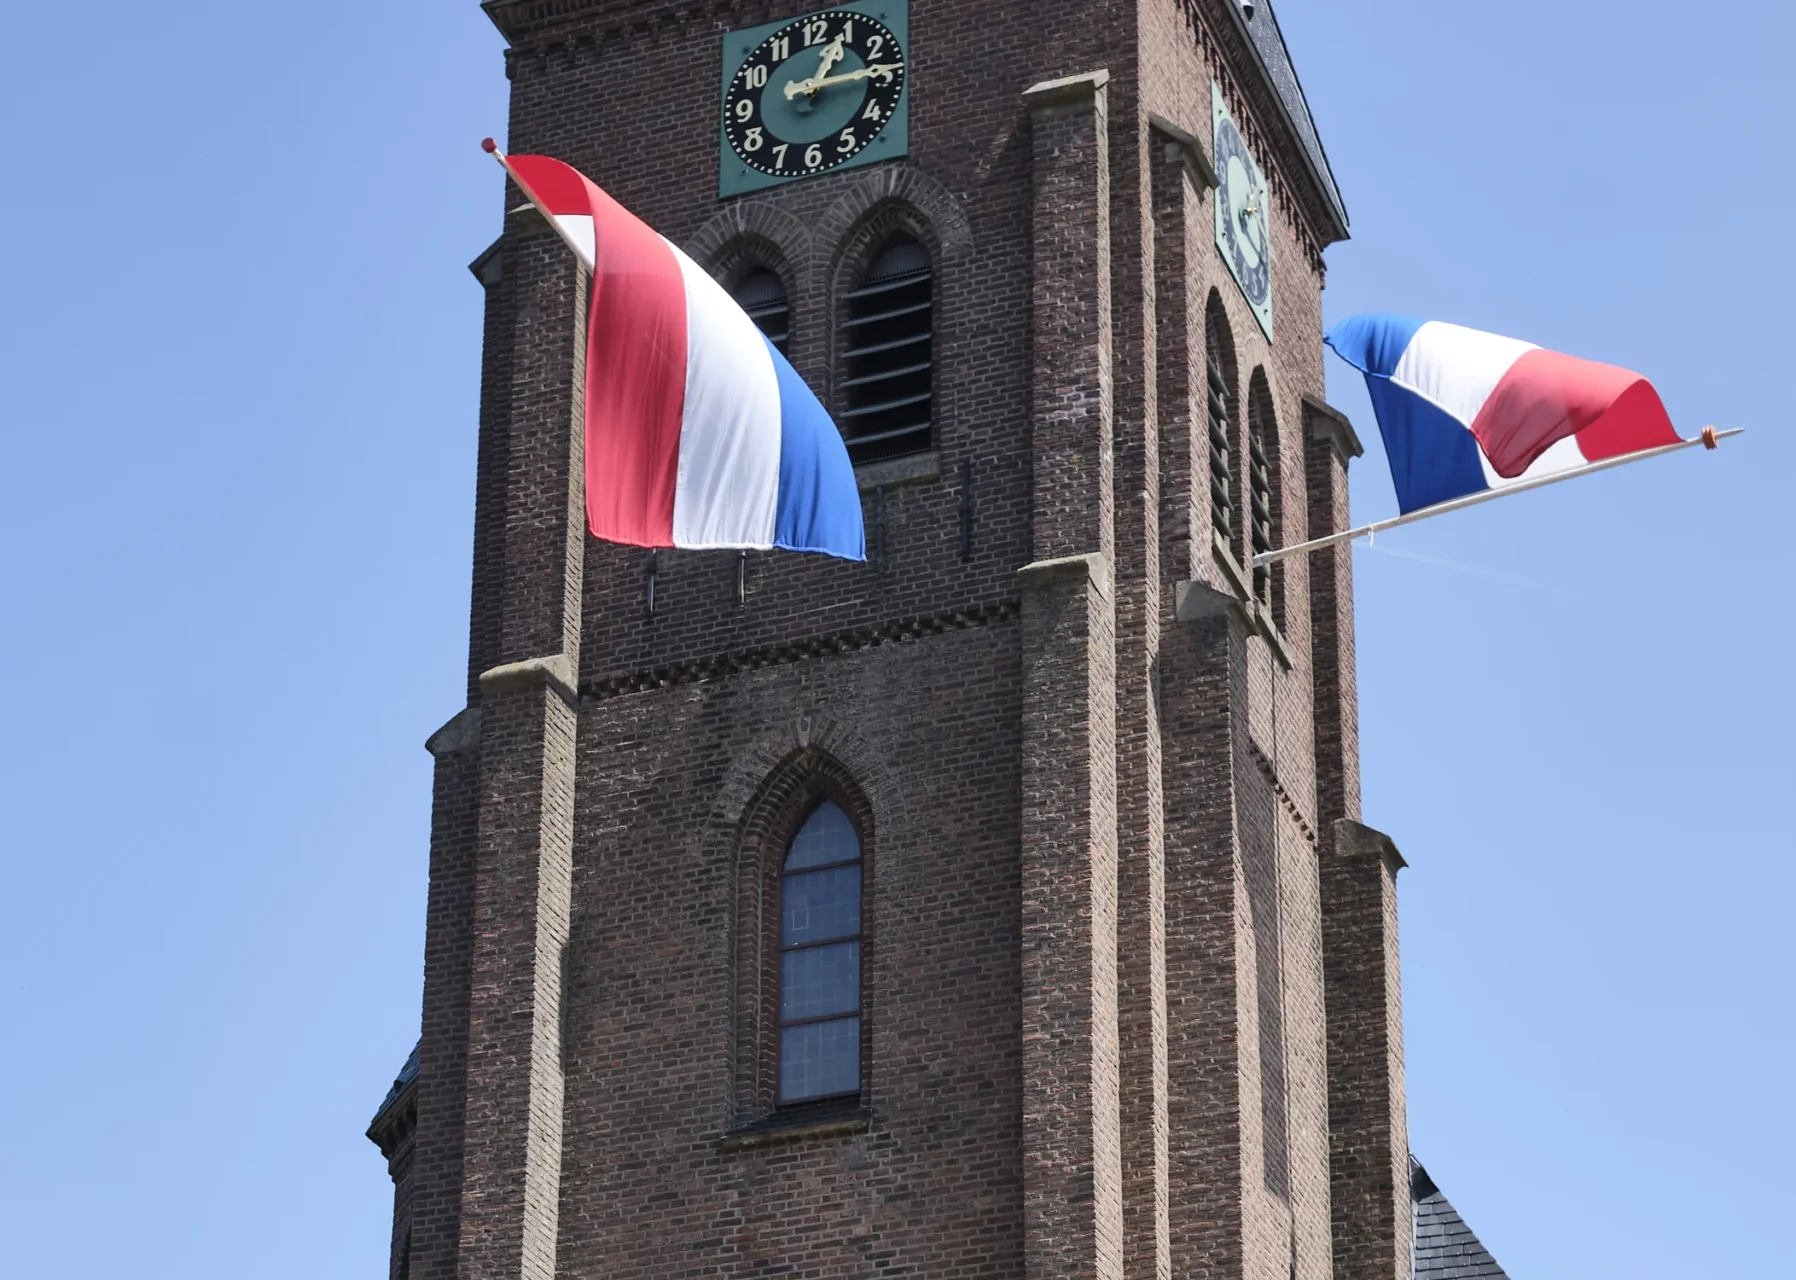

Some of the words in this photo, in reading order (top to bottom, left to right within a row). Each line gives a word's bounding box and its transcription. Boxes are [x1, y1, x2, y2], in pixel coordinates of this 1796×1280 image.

[802, 20, 828, 47] 12
[843, 20, 853, 43] 1
[770, 36, 790, 62] 11
[866, 35, 883, 60] 2
[744, 64, 768, 90] 10
[735, 99, 754, 123] 9
[862, 98, 881, 121] 4
[743, 127, 764, 152] 8
[836, 127, 856, 153] 5
[772, 143, 789, 169] 7
[804, 143, 822, 168] 6
